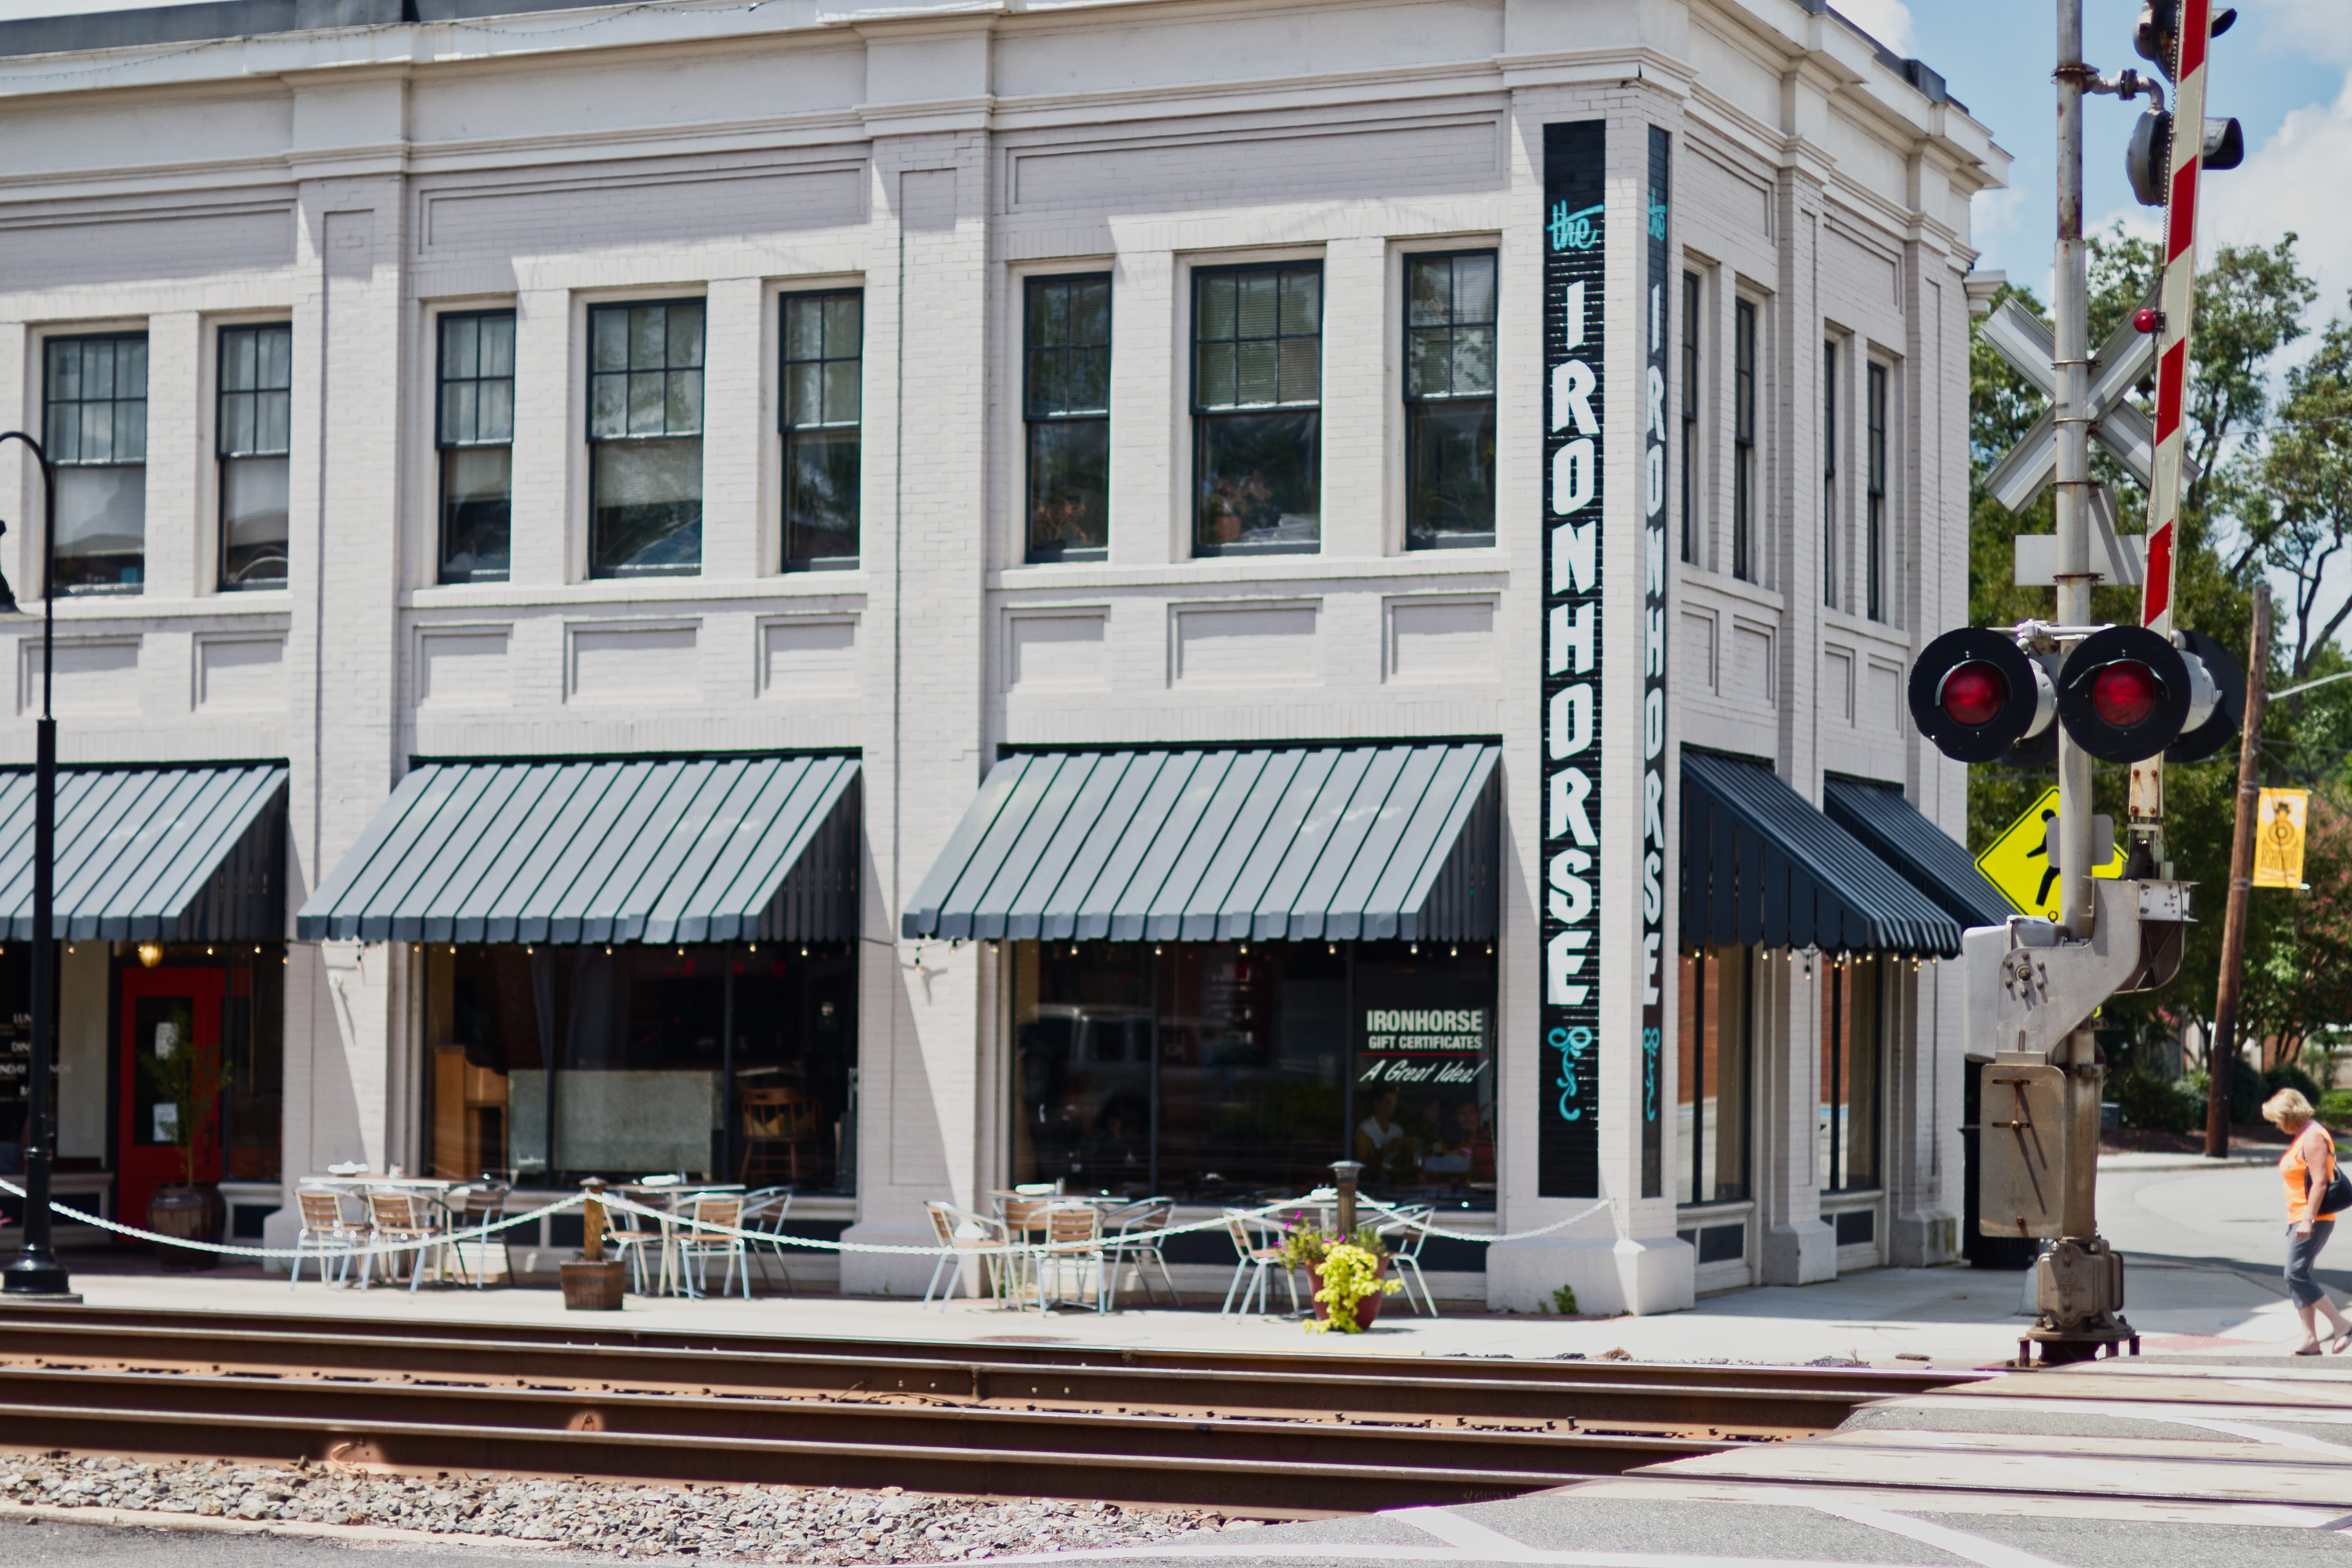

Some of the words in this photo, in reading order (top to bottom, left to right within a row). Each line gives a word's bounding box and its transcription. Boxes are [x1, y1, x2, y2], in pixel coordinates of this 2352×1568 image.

[1546, 200, 1604, 250] the
[1648, 188, 1667, 241] the
[1548, 280, 1601, 1005] IRONHORSE
[1643, 283, 1666, 1005] IRONHORSE
[13, 1013, 33, 1024] LUN
[1367, 1010, 1483, 1032] IRONHORSE
[1368, 1035, 1396, 1049] GIFT
[1398, 1035, 1483, 1049] CERTIFICATES
[1359, 1059, 1387, 1082] A
[1384, 1059, 1438, 1082] Great
[1433, 1059, 1489, 1083] Idea!
